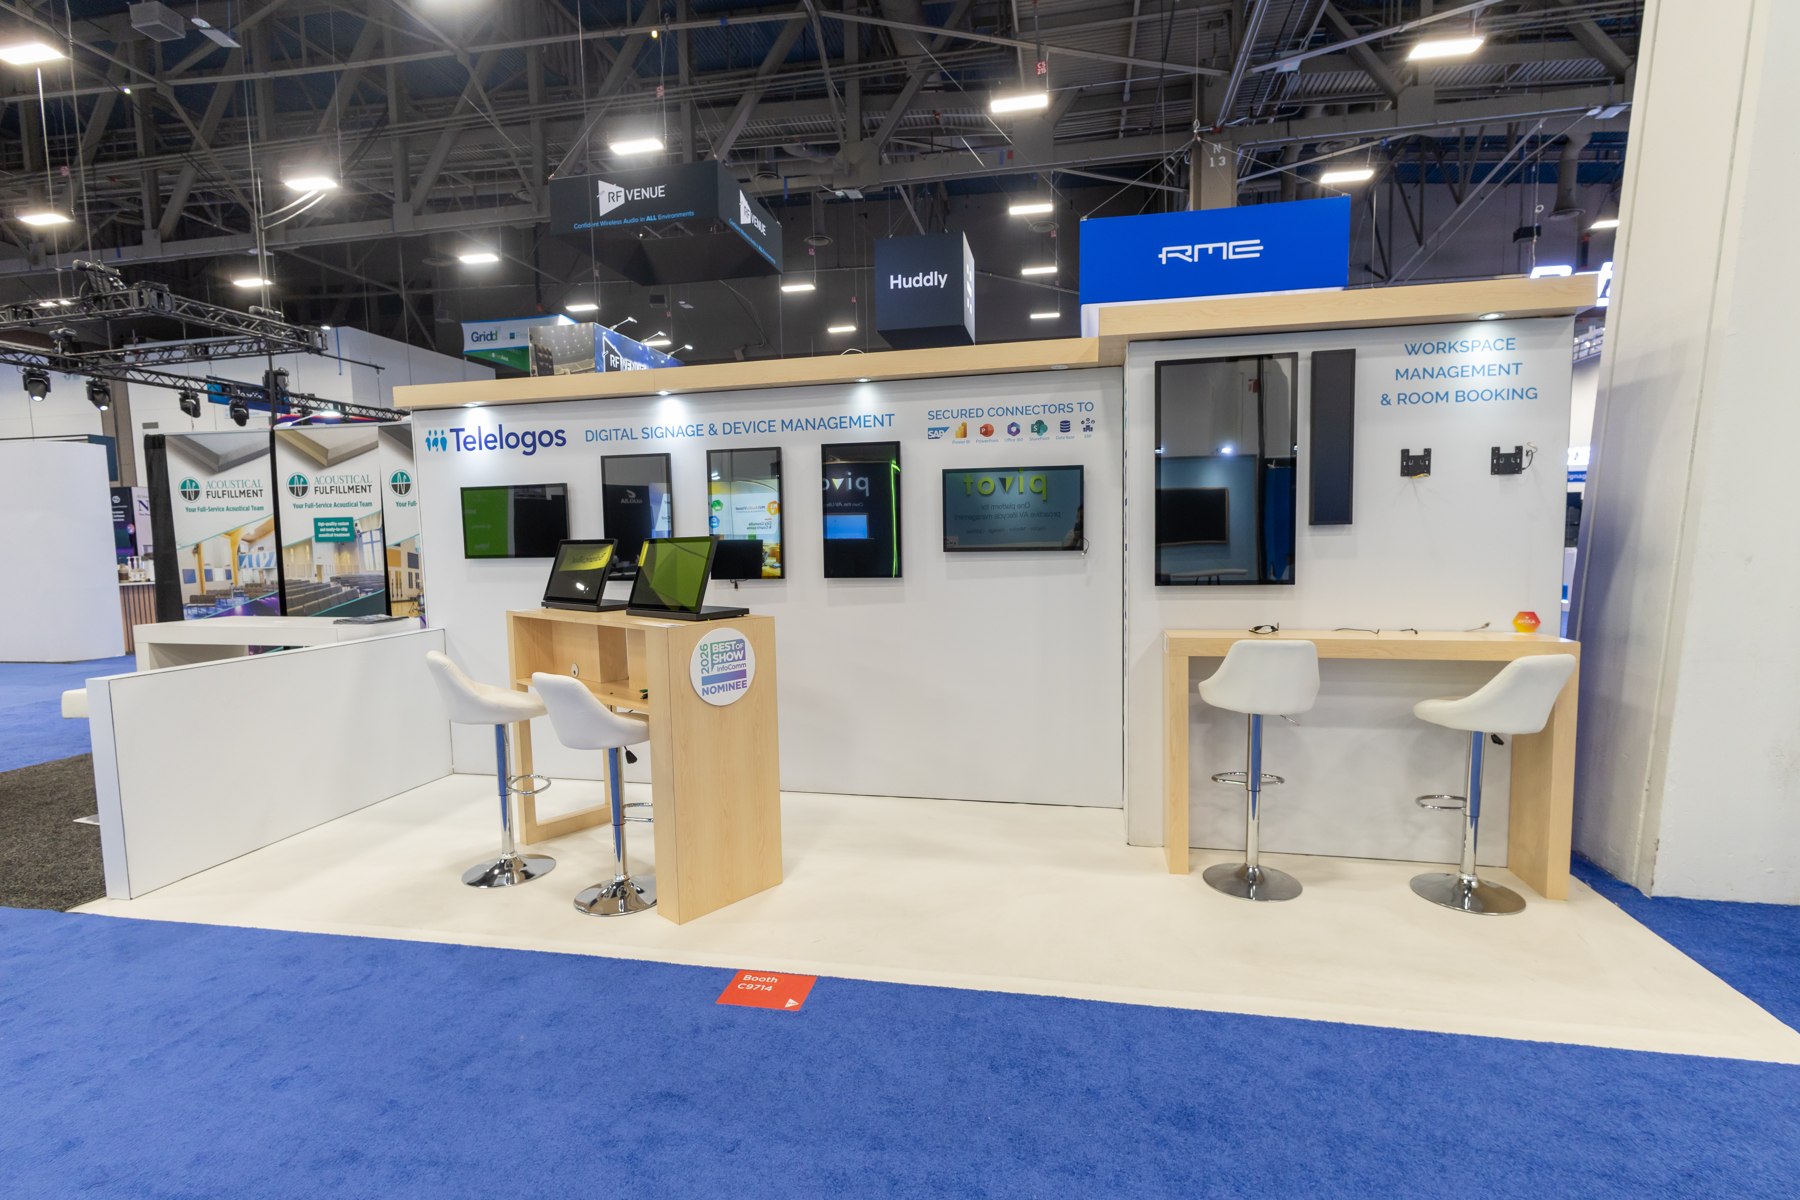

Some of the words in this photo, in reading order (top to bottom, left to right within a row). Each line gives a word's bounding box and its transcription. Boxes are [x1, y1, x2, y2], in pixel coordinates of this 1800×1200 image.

[1210, 156, 1226, 167] 13
[608, 190, 622, 202] RF
[626, 185, 666, 200] VENUE
[658, 210, 695, 220] Environments
[1158, 238, 1264, 265] RME
[889, 270, 948, 290] Huddly
[471, 330, 498, 342] Gridd
[1404, 338, 1516, 356] WORKSPACE
[610, 354, 620, 368] RF
[1396, 362, 1524, 381] MANAGEMENT
[1380, 393, 1392, 406] &
[1397, 391, 1450, 406] ROOM
[1455, 387, 1538, 403] BOOKING
[928, 408, 984, 420] SECURED
[988, 402, 1074, 417] CONNECTORS
[1077, 402, 1094, 412] TO
[585, 427, 638, 442] DIGITAL
[641, 423, 704, 440] SIGNAGE
[708, 423, 718, 436] &
[722, 420, 776, 436] DEVICE
[781, 413, 896, 432] MANAGEMENT
[928, 430, 945, 439] SAP
[450, 424, 567, 456] Telelogos
[206, 480, 263, 489] ACOUSTICAL
[314, 474, 372, 485] ACOUSTICAL
[206, 489, 263, 499] FULFILLMENT
[314, 484, 372, 495] FULFILLMENT
[712, 641, 736, 653] BEST
[700, 644, 709, 674] 2026
[712, 650, 744, 664] SHOW
[717, 662, 746, 672] InfoComm
[702, 680, 747, 696] NOMINEE
[743, 974, 778, 984] Booth
[737, 983, 773, 992] C9714
